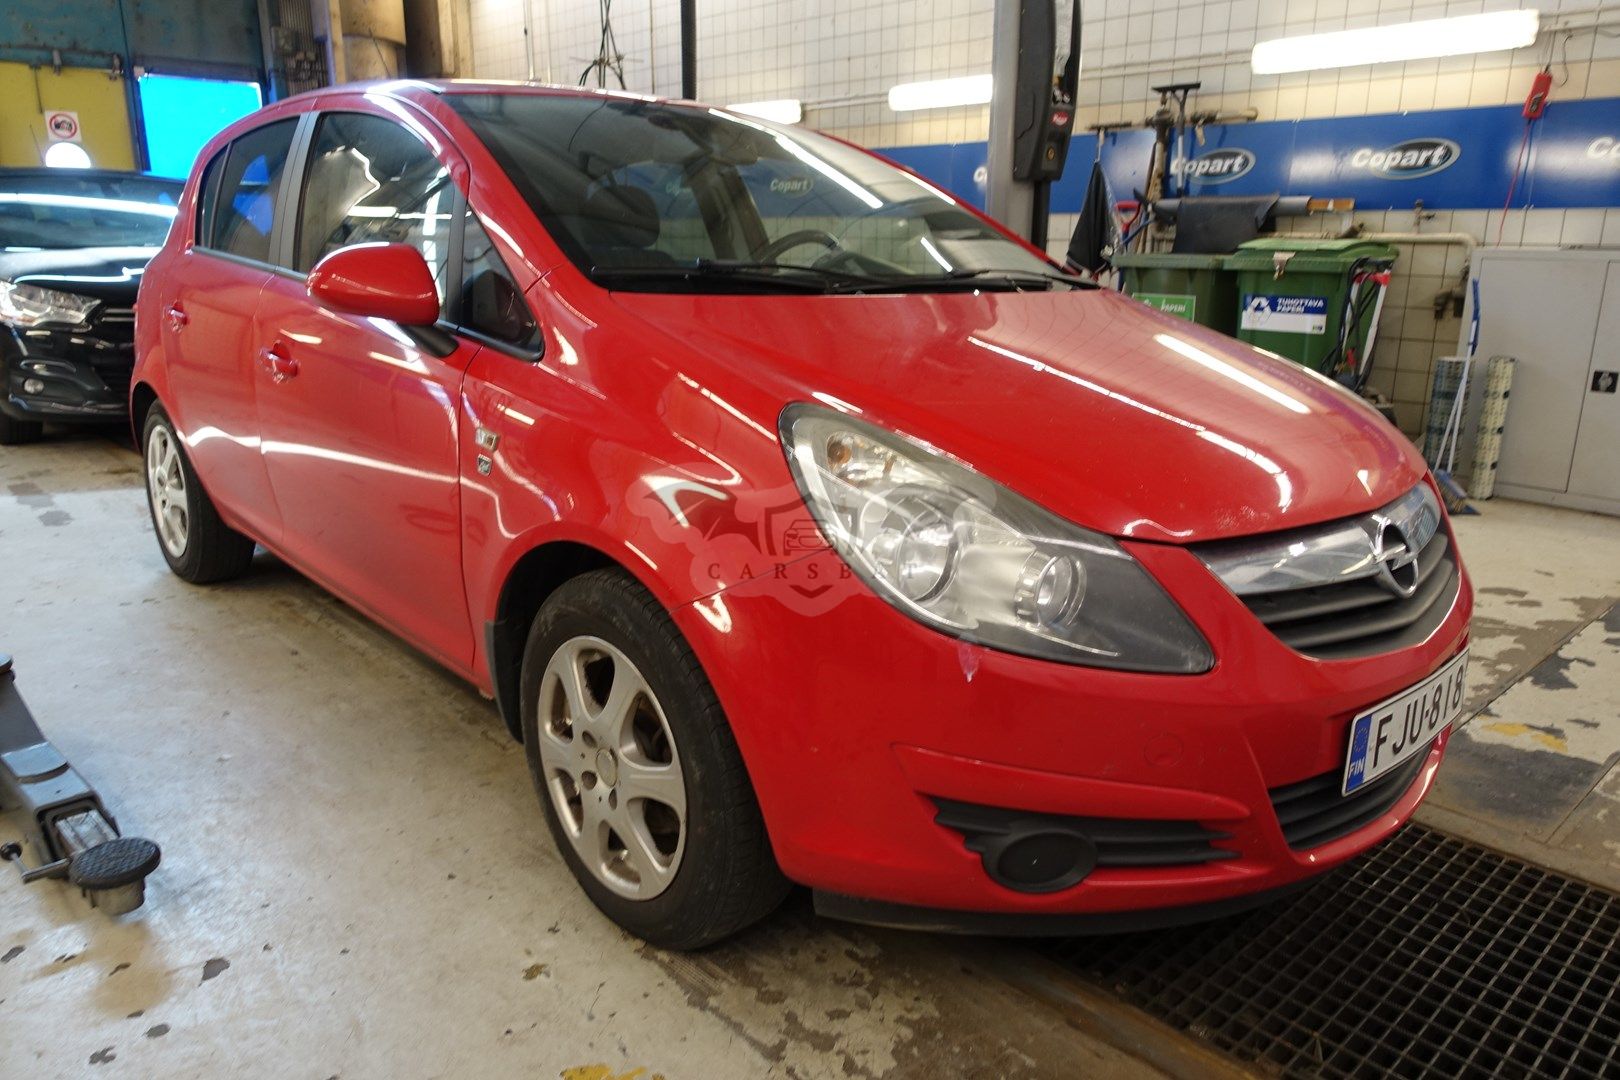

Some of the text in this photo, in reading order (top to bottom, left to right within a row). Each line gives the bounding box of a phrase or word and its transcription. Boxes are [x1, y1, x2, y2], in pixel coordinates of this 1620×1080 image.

[1170, 153, 1245, 177] Copart
[1352, 143, 1446, 173] Copart
[769, 177, 808, 193] Copart
[1372, 664, 1464, 769] FJU-818
[1349, 756, 1366, 777] FIN
